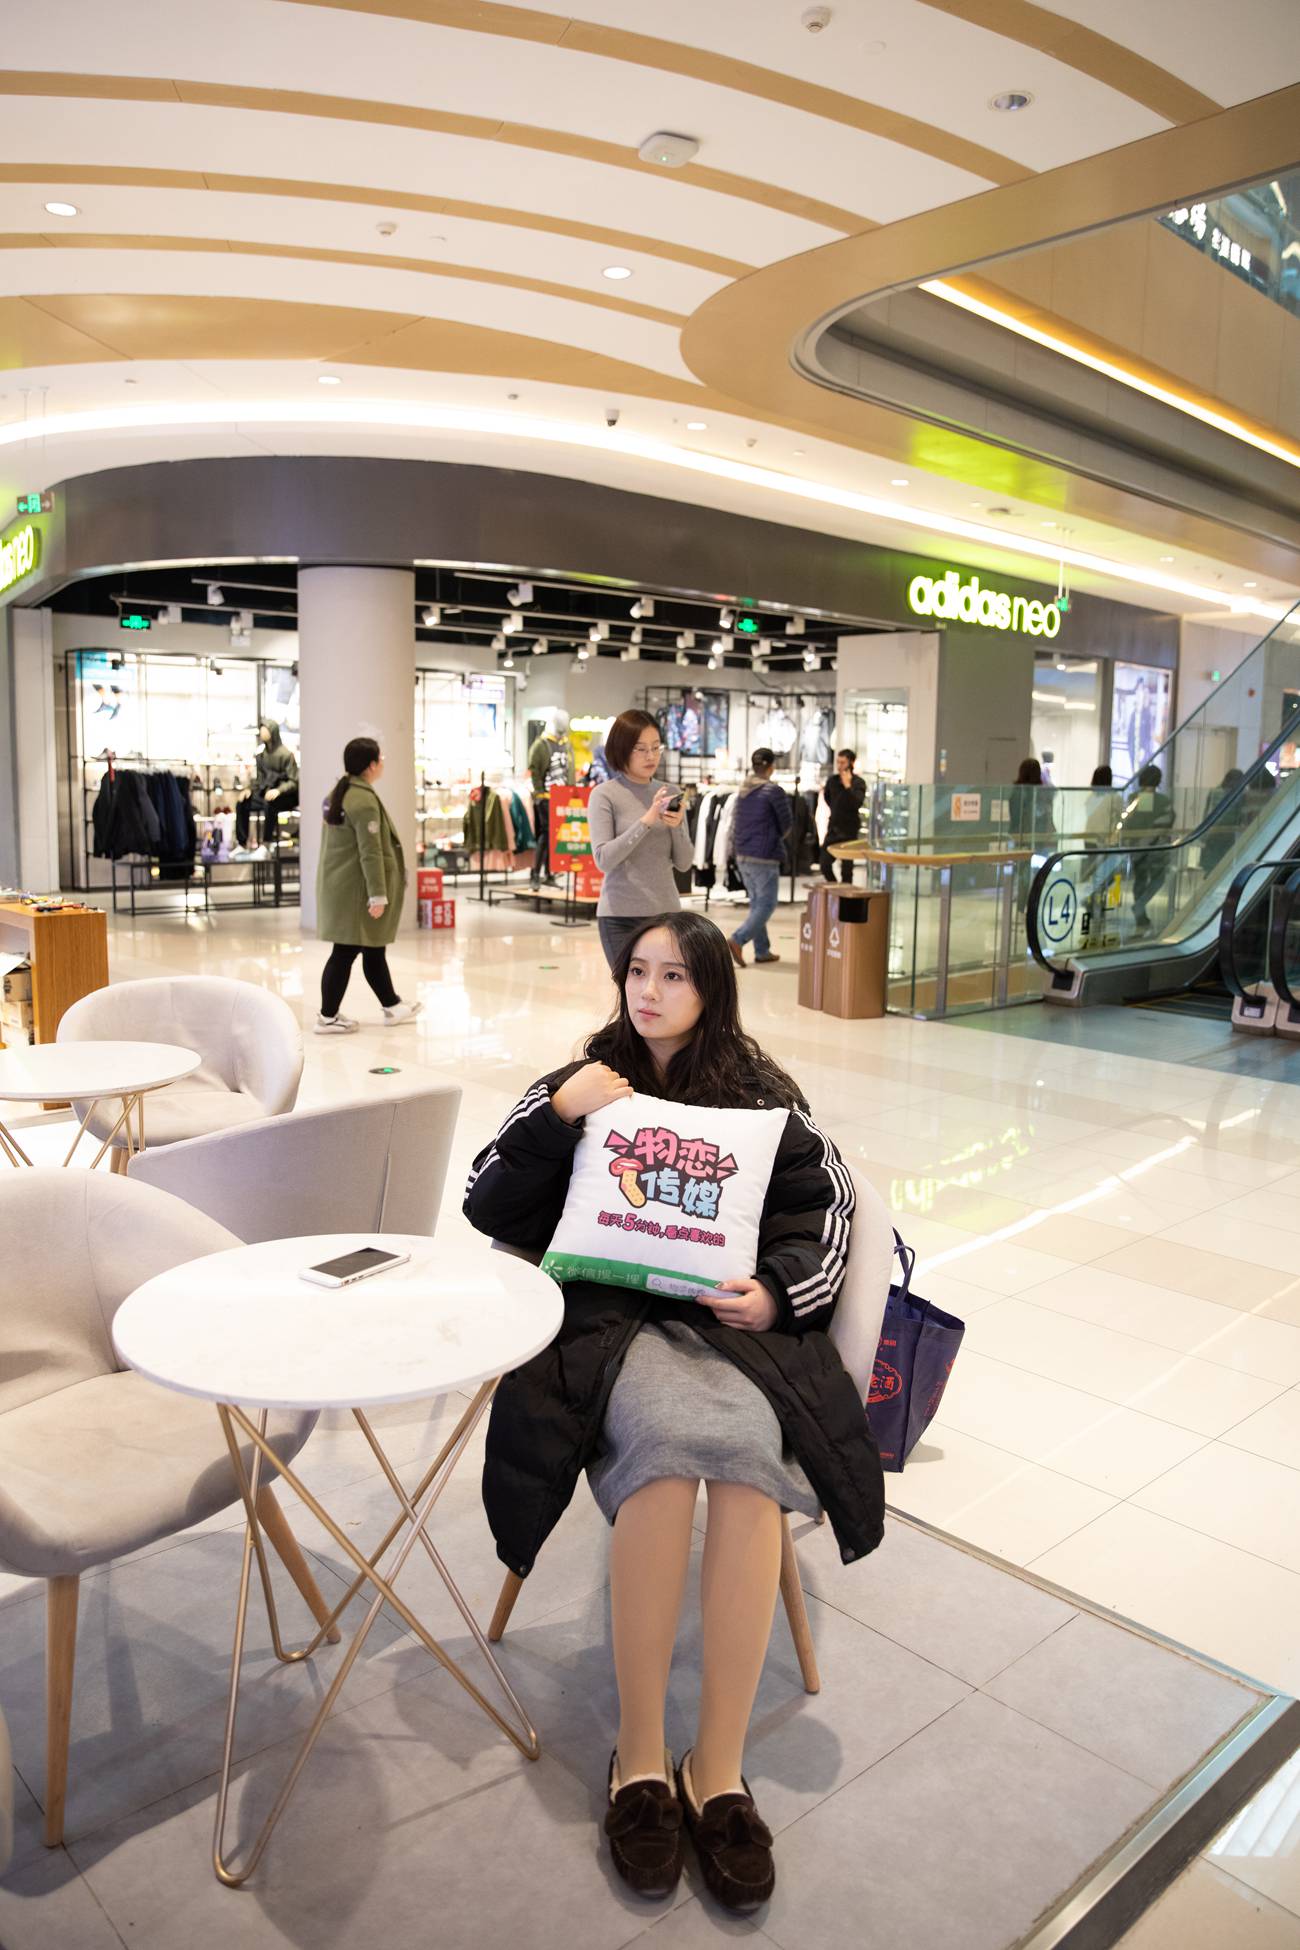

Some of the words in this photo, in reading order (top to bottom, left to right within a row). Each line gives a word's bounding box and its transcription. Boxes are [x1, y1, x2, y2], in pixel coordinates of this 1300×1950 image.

[909, 571, 1011, 630] adidas
[1013, 597, 1061, 638] neo
[1048, 894, 1071, 925] L4
[633, 1127, 720, 1180] 物恋
[640, 1167, 721, 1220] 传媒
